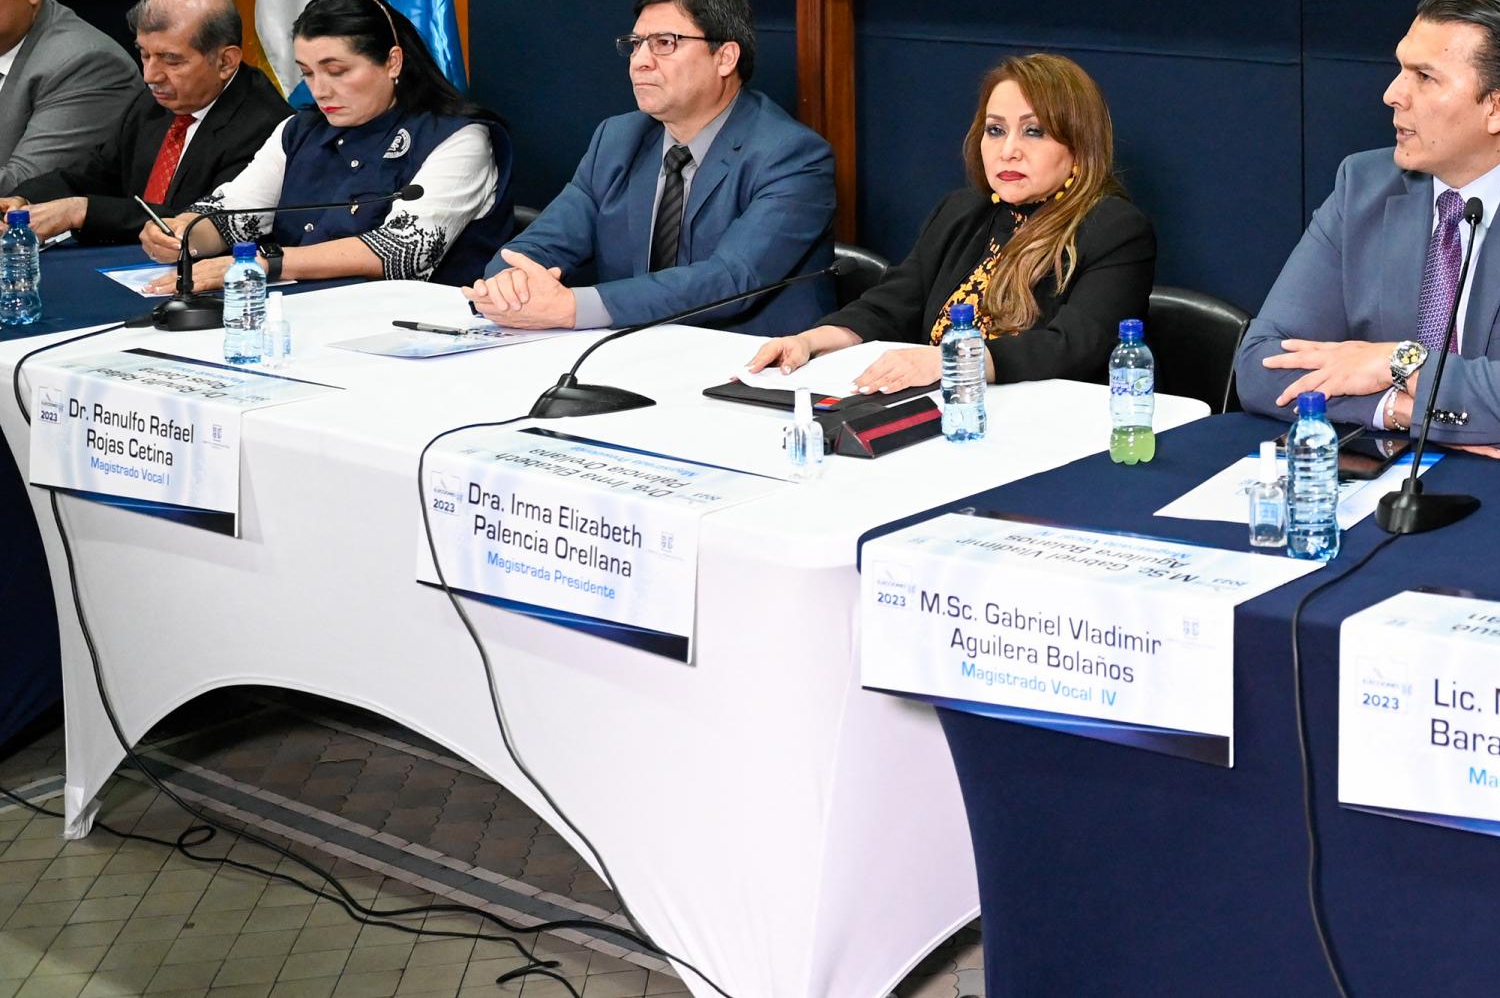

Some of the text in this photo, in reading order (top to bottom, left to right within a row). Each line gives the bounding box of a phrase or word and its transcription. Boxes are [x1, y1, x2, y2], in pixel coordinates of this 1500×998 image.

[40, 410, 58, 422] 2023
[69, 398, 195, 444] Dr. Ranulfo Rafael
[86, 429, 173, 466] Rojas Cetina
[494, 452, 574, 477] Elizabeth
[90, 457, 140, 479] Magistrado
[142, 468, 165, 485] Vocal
[529, 448, 689, 488] Palencia Orellana
[578, 472, 629, 489] Irma
[433, 498, 456, 513] 2023
[468, 482, 642, 549] Dra. Irma Elizabeth
[474, 515, 632, 578] Palencia Orellana
[954, 537, 1044, 558] Vladimir
[1044, 552, 1129, 572] Gabriel
[487, 551, 616, 600] Magistrada Presidente
[877, 592, 907, 608] 2023
[920, 590, 1162, 657] M.Sc. Gabriel Vladimir
[950, 628, 1135, 684] Aguilera Bolaños
[961, 661, 1117, 706] Magistrado Vocal IV
[1433, 679, 1482, 713] Lic.
[1362, 693, 1401, 712] 2023
